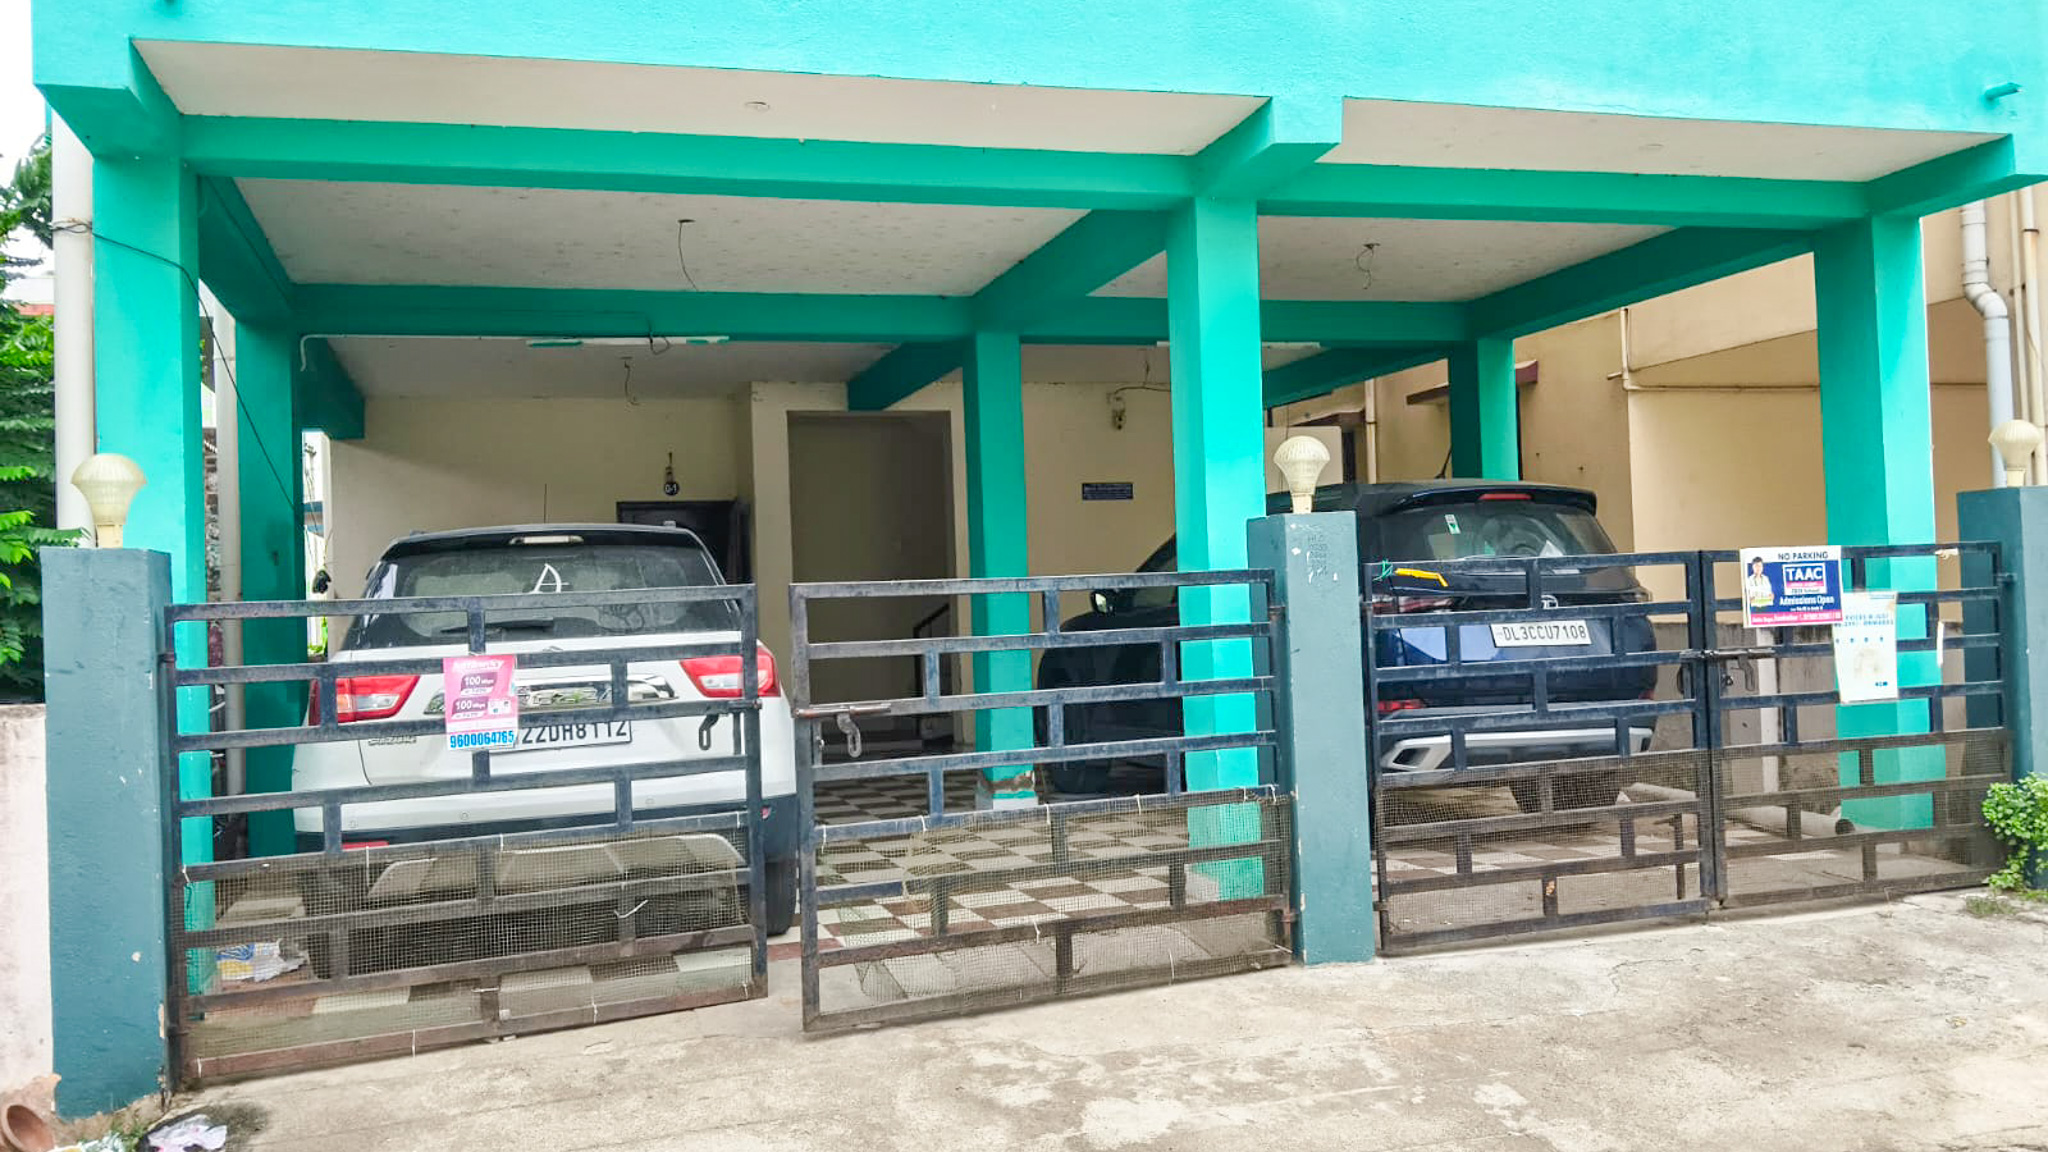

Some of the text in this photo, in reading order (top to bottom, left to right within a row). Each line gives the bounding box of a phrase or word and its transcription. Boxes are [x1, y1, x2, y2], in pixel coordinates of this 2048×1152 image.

[1793, 552, 1828, 560] PARKING
[1786, 567, 1823, 581] TAAC
[1502, 625, 1587, 641] DL3CCU7108
[465, 676, 480, 685] 100
[456, 700, 472, 710] 100
[450, 730, 514, 748] 9600064765
